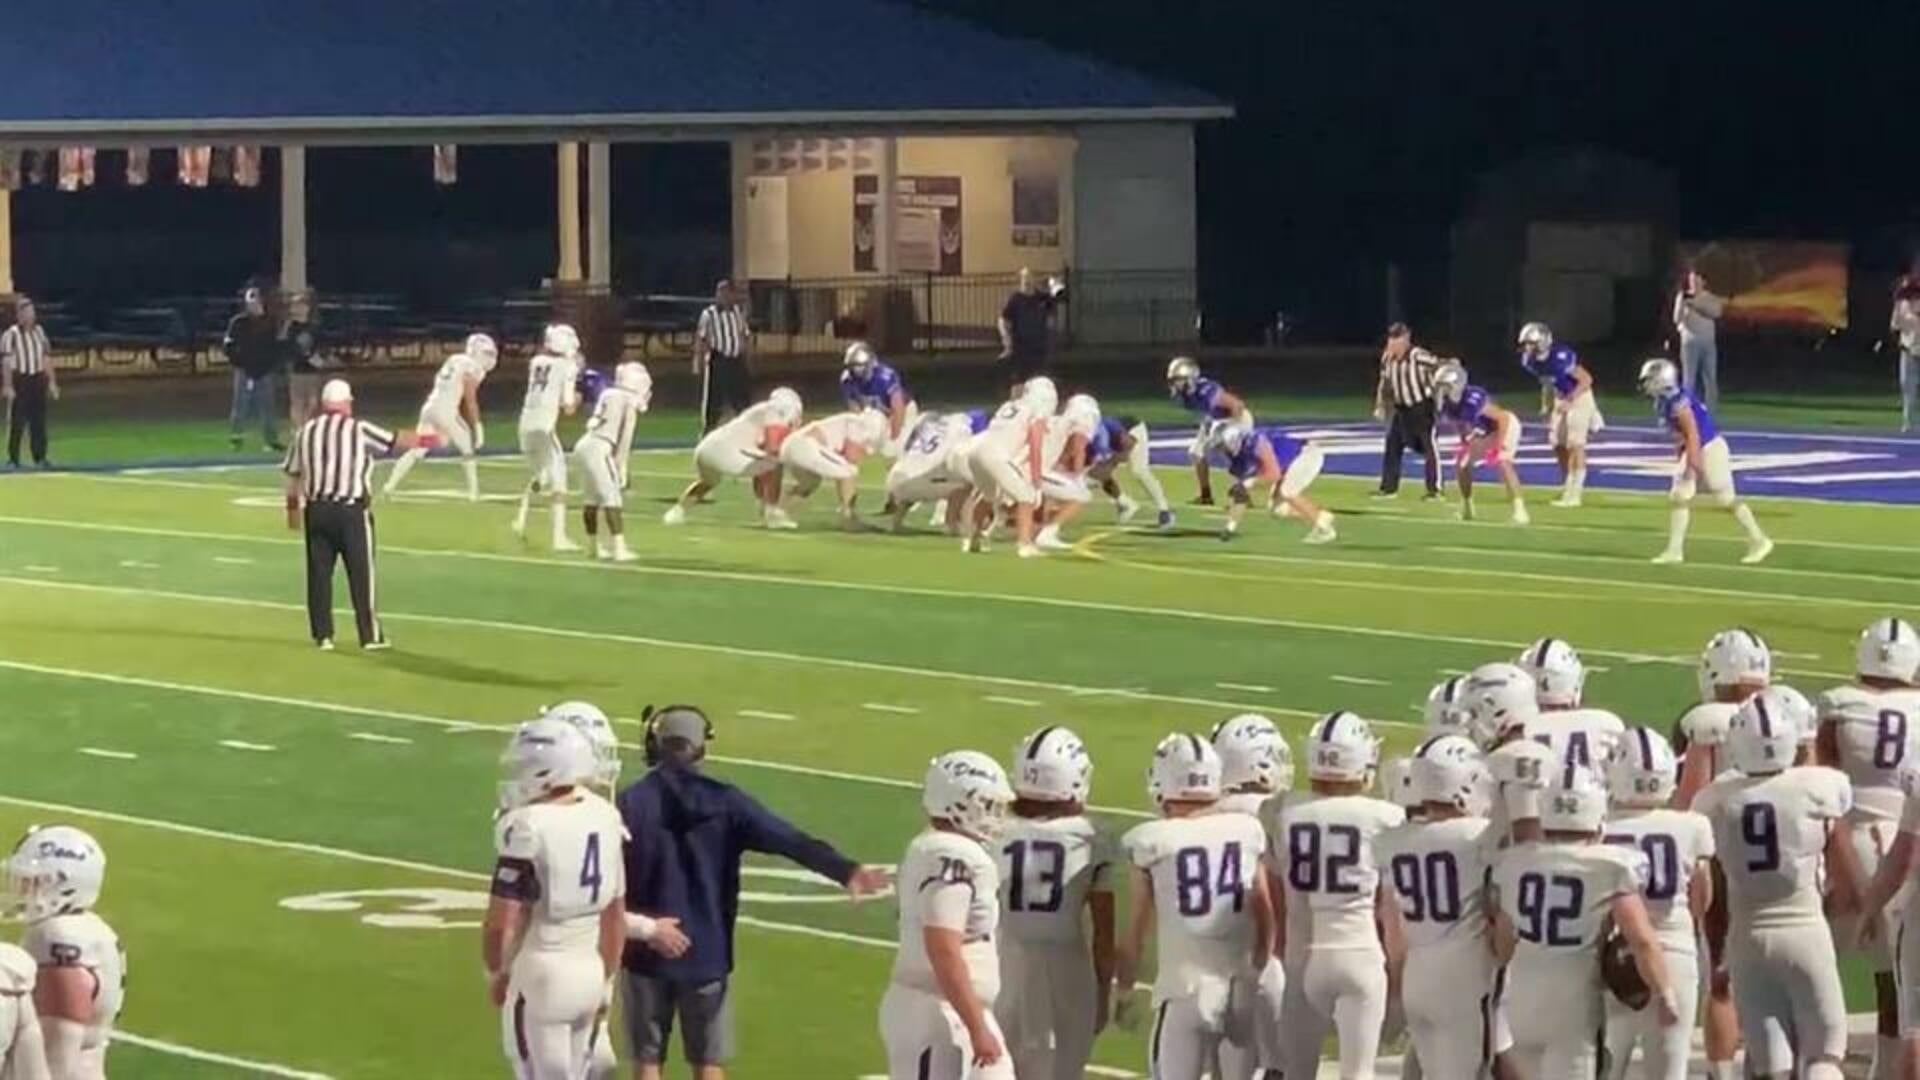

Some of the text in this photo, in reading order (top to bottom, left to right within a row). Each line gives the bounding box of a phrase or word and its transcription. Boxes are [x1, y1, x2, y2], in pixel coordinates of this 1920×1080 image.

[1875, 708, 1908, 769] 8
[580, 832, 602, 904] 4
[1289, 822, 1363, 894] 82
[1742, 802, 1780, 873] 9
[1003, 839, 1067, 913] 13
[1176, 841, 1244, 917] 84
[1392, 850, 1459, 922] 90
[1518, 873, 1585, 946] 92
